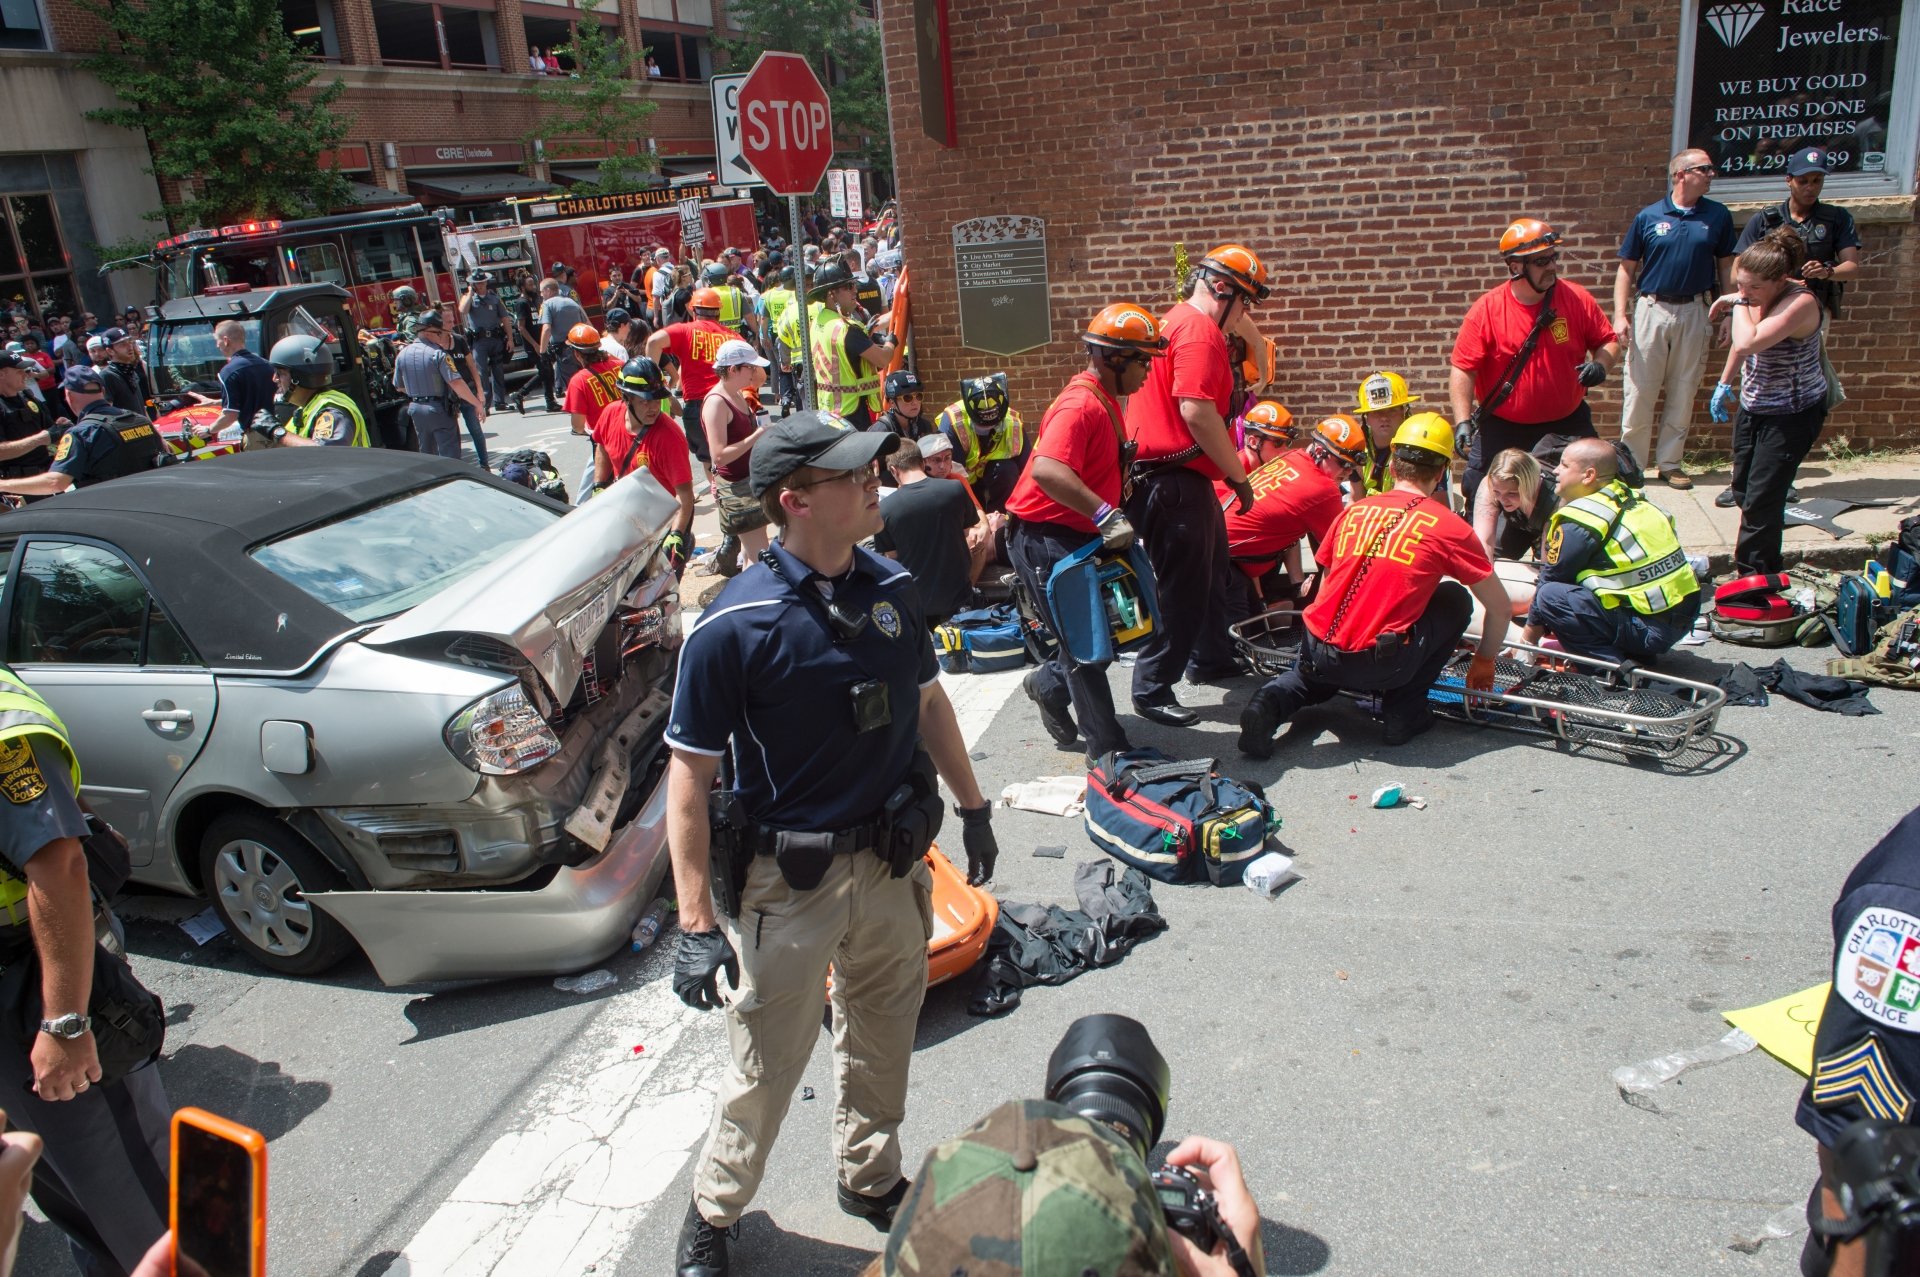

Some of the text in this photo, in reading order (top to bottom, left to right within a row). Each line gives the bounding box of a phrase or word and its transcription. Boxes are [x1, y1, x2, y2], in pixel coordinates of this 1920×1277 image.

[1781, 0, 1841, 14] Race
[1777, 21, 1879, 52] Jewelers
[1719, 73, 1867, 96] WE BUY GOLD
[1715, 100, 1866, 122] REPAIRS DONE
[747, 100, 826, 151] STOP
[1720, 120, 1857, 142] ON PREMISES
[436, 147, 465, 160] CBRE
[558, 185, 709, 215] CHARLOTTESVILLE FIRE
[680, 198, 701, 221] NO!
[120, 424, 154, 441] STATE POLICE
[1336, 505, 1439, 566] FIRE
[1638, 559, 1673, 581] STATE
[1, 767, 40, 788] VIRGINIA
[9, 774, 39, 793] STATE
[14, 781, 45, 800] POLICE
[1853, 990, 1908, 1024] POLICE
